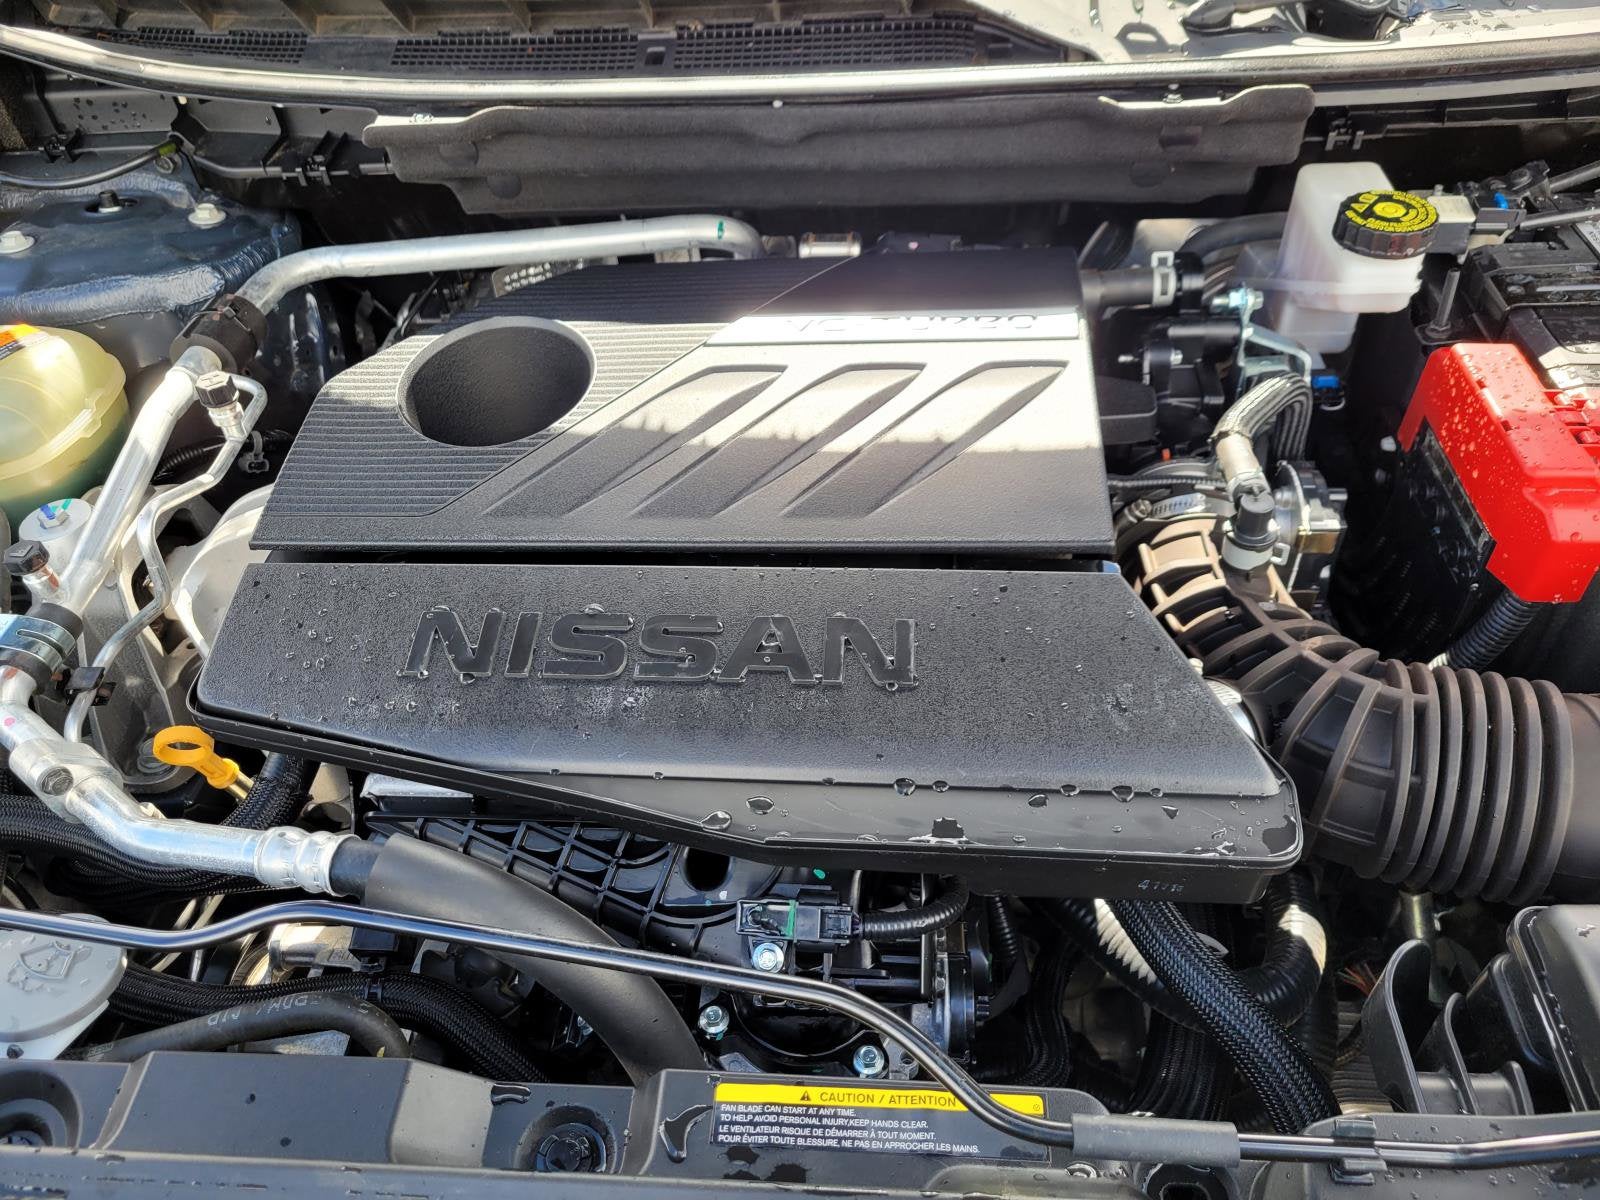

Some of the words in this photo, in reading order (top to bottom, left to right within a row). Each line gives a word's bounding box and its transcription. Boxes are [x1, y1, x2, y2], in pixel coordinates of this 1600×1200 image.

[401, 610, 918, 687] NISSAN
[820, 1092, 874, 1103] CAUTION
[878, 1095, 885, 1104] /
[889, 1094, 956, 1107] ATTENTION
[782, 1106, 806, 1114] START
[779, 1116, 820, 1124] PERSONAL
[871, 1120, 900, 1128] HANDS
[730, 1125, 780, 1134] VENTILATEUR
[782, 1126, 811, 1135] RISQUE
[825, 1126, 869, 1138] DÉMARRER
[870, 1128, 876, 1138] À
[878, 1130, 899, 1139] TOUT
[900, 1132, 936, 1140] MOMENT.
[742, 1134, 768, 1143] ÉVITER
[770, 1136, 795, 1144] TOUTE
[797, 1137, 840, 1147] BLESSURE,
[884, 1141, 935, 1150] APPROCHER
[936, 1143, 951, 1151] LES
[952, 1144, 980, 1153] MAINS.
